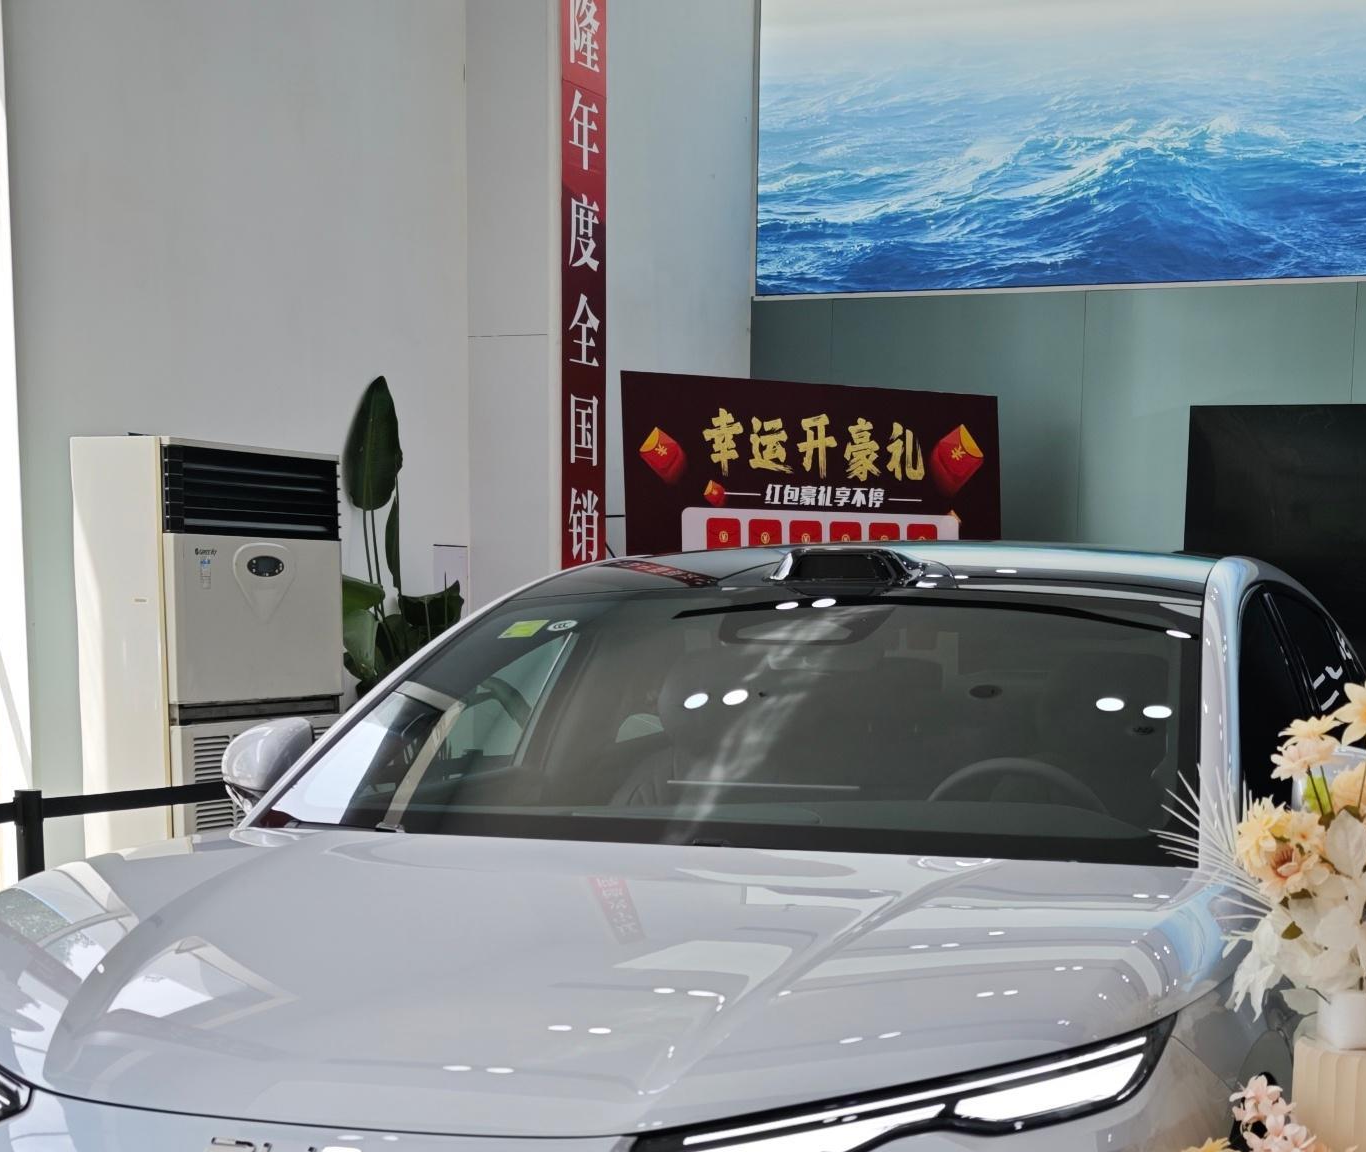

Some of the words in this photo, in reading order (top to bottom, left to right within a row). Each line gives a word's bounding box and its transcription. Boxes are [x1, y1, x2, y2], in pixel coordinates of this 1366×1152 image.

[702, 407, 925, 481] 幸运开豪礼
[765, 483, 885, 508] 红包豪礼享不停
